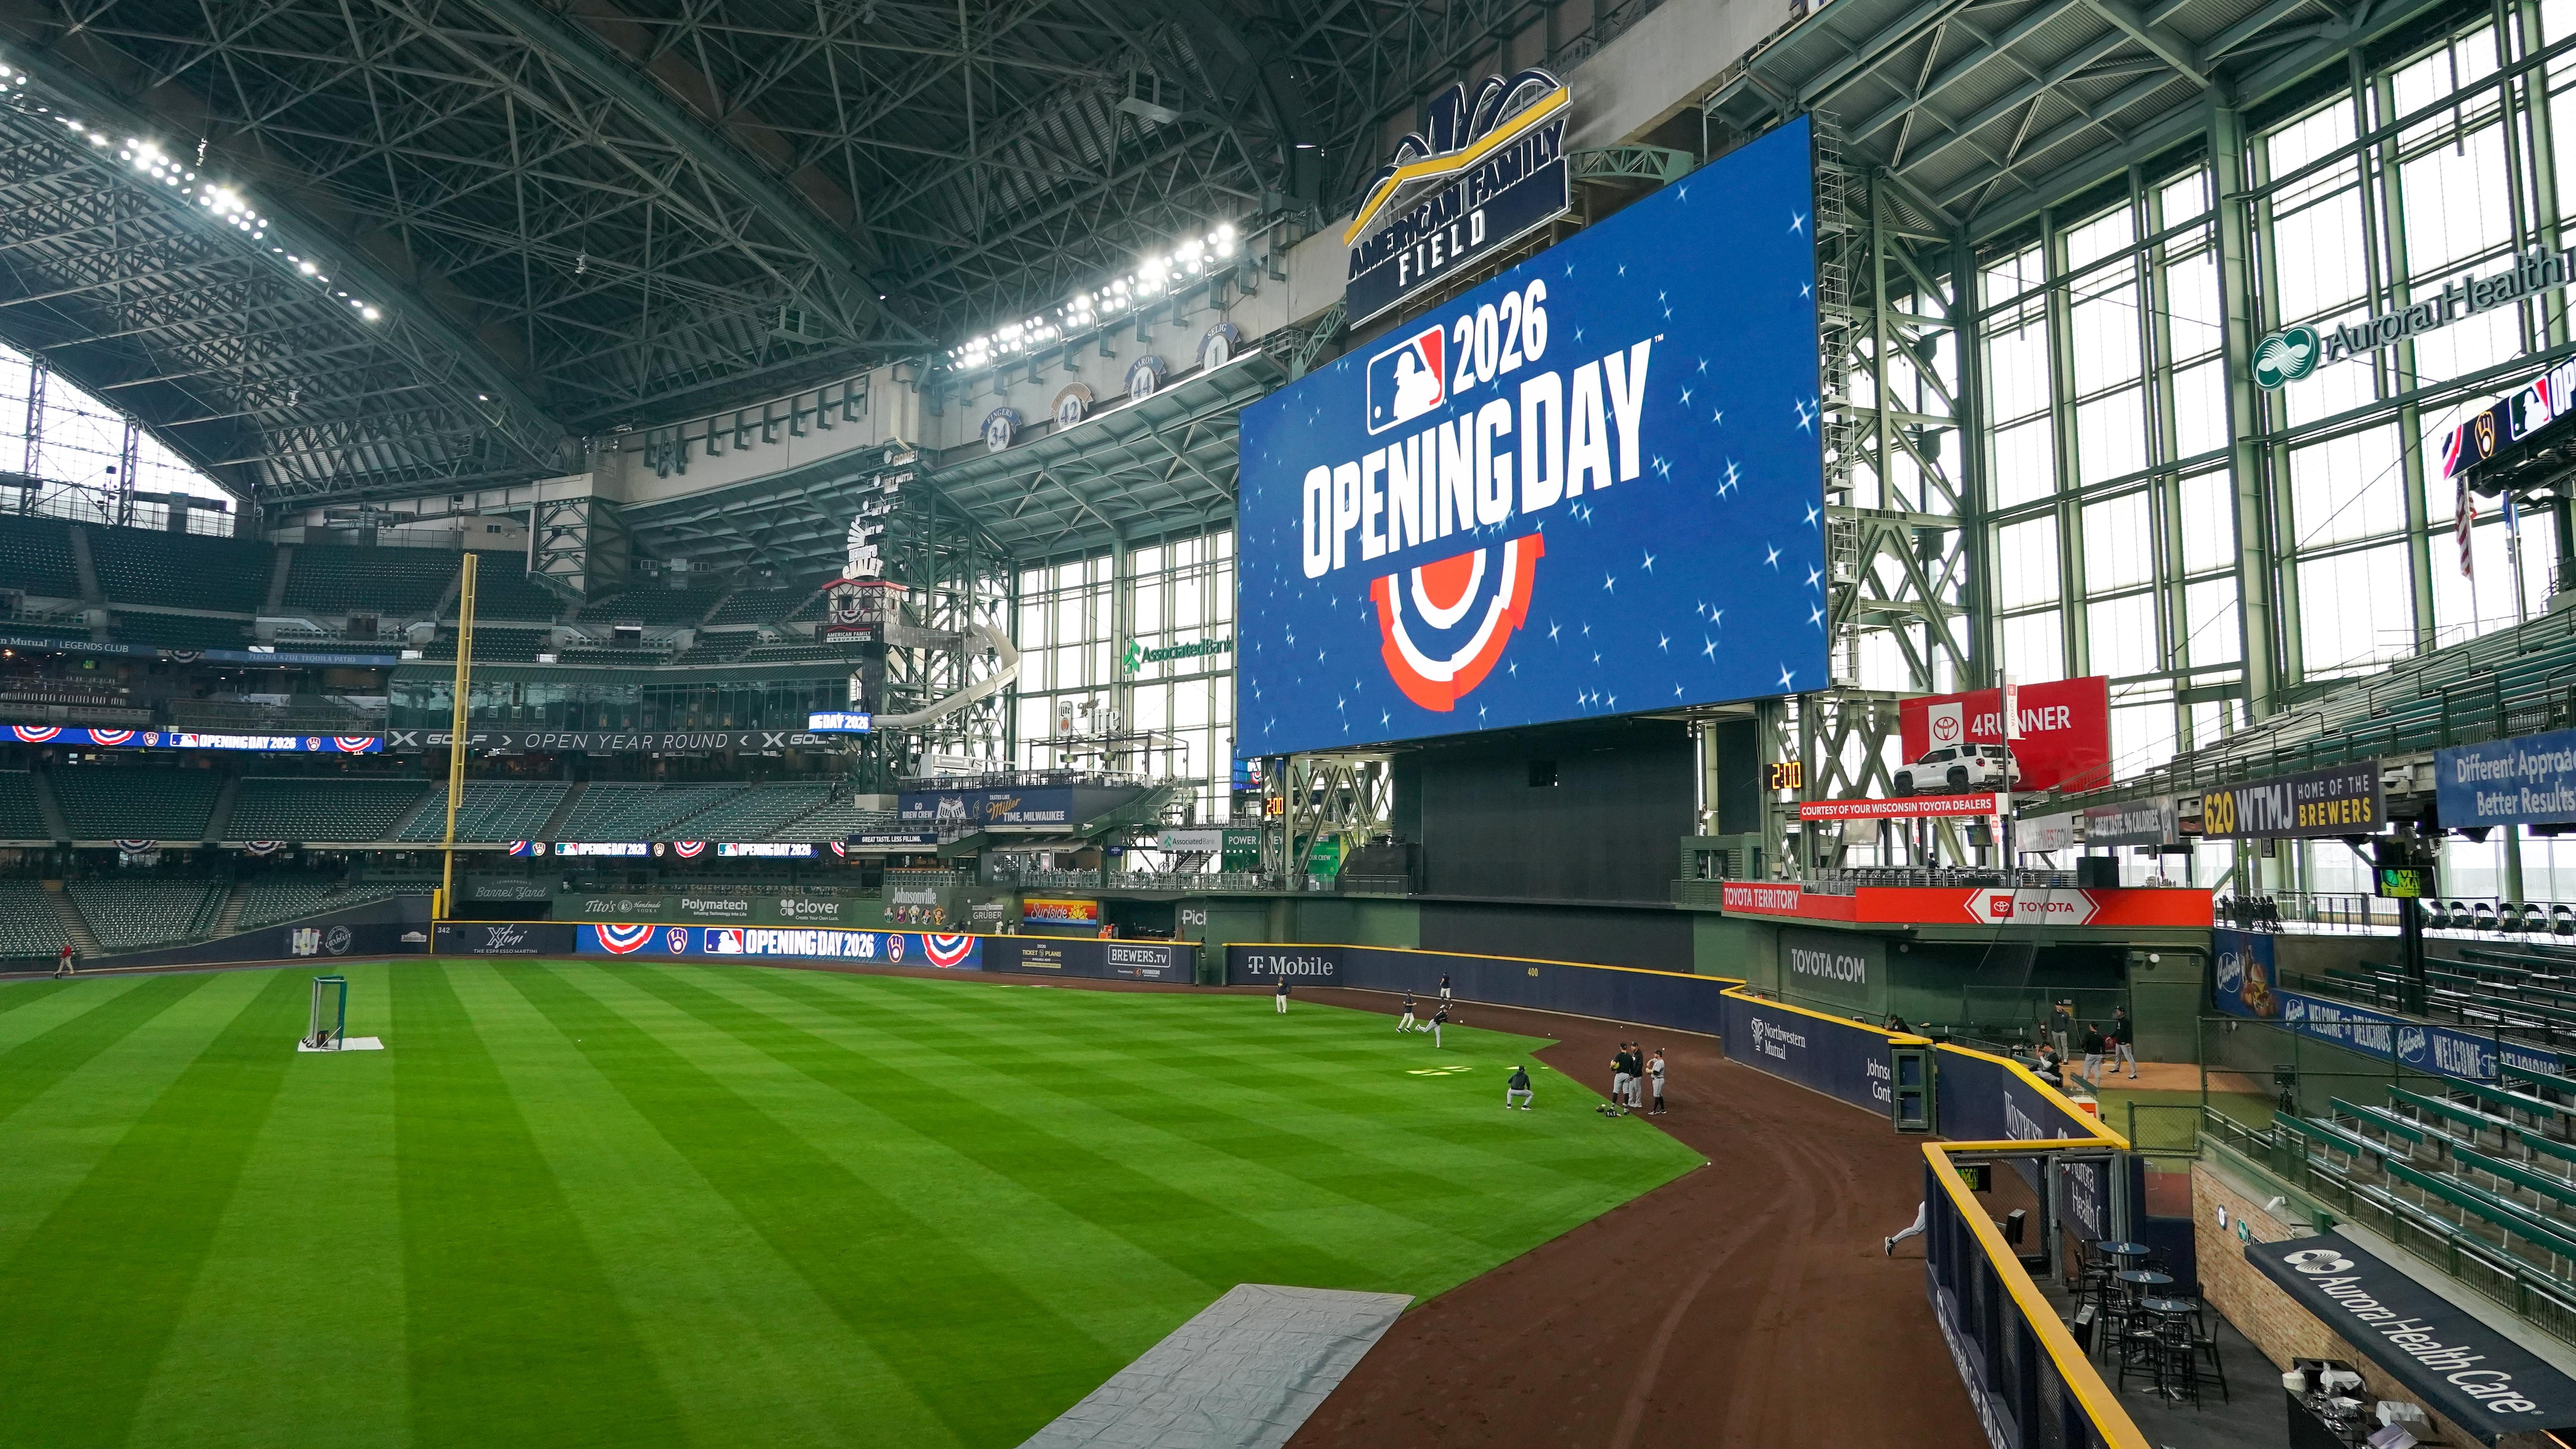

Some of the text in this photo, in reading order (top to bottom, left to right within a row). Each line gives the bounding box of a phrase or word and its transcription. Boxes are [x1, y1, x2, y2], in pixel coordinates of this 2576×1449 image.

[1348, 113, 1568, 280] AMERICAN FAMILY
[1399, 209, 1486, 287] FIELD
[2327, 300, 2438, 364] Aurora
[2441, 242, 2568, 324] Health
[1207, 323, 1227, 340] SELIG
[1452, 278, 1547, 395] 2026
[1133, 356, 1154, 371] AARON
[1213, 344, 1219, 366] 1
[1133, 373, 1152, 397] 44
[987, 408, 1013, 425] FINGERS
[1061, 401, 1080, 425] 42
[990, 424, 1008, 448] 34
[893, 449, 919, 467] GONE!
[1303, 338, 1652, 579] OPENING DAY
[884, 472, 913, 486] GET OUTTA
[883, 504, 891, 514] UP
[876, 525, 884, 534] UP
[849, 544, 877, 563] BERNIE'S
[842, 557, 884, 580] CHALET
[10, 638, 47, 647] Mutual
[59, 640, 103, 651] LEGENDS
[104, 644, 129, 652] CLUB
[1061, 706, 1071, 717] Lite
[1077, 699, 1101, 718] Miller
[823, 714, 845, 729] DAY
[844, 715, 869, 730] 2026
[1087, 709, 1121, 739] Lite
[199, 734, 297, 750] OPENING DAY 2026
[525, 734, 728, 749] OPEN YEAR ROUND
[1772, 761, 1802, 790] 2:00
[2456, 753, 2515, 783] Different
[2298, 774, 2369, 799] HOME OF THE
[914, 802, 923, 811] GO
[1266, 797, 1284, 815] 2:00
[1801, 798, 1992, 816] COURTESY OF YOUR WISCONSIN TOYOTA DEALERS
[2477, 781, 2575, 816] Better Results
[903, 810, 933, 819] BREW CREW
[986, 798, 1022, 821] Miller
[1004, 811, 1065, 823] TIME, MILWAUKEE
[2205, 783, 2293, 835] 620 WTMJ
[2299, 797, 2371, 827] BREWERS
[2095, 815, 2108, 836] GREAT
[2124, 812, 2132, 834] 96
[2132, 809, 2161, 833] CALORIES.
[578, 843, 647, 855] OPENING DAY 2026
[738, 843, 811, 856] OPENING DAY 2026
[1228, 836, 1257, 846] POWER
[475, 886, 546, 900] Barrel Yard
[892, 886, 937, 905] Johnsonville
[1724, 887, 1799, 910] TOYOTA TERRITORY
[585, 899, 616, 913] Tito's
[682, 898, 748, 912] Polymatech
[795, 899, 839, 914] clover
[1031, 903, 1067, 920] Surfside
[2019, 902, 2075, 913] TOYOTA
[973, 911, 1002, 920] GRUBER
[746, 929, 874, 958] OPENING DAY 2026
[1112, 949, 1167, 963] BREWERS.TV
[1268, 956, 1333, 975] Mobile
[1528, 967, 1538, 976] 400
[1791, 948, 1865, 984] TOYOTA.COM
[2217, 951, 2241, 990] Culver's
[1765, 1022, 1806, 1049] Northwestern
[2285, 1000, 2305, 1026] Culver's
[2309, 1004, 2343, 1039] WELCOME
[2352, 1014, 2392, 1053] DELICIOUS
[2398, 1026, 2426, 1058] Culver's
[2433, 1035, 2482, 1079] WELCOME
[1765, 1039, 1786, 1060] Mutual
[2072, 1181, 2096, 1233] Health
[2309, 1276, 2536, 1413] Aurora Health Care
[1944, 1309, 1980, 1413] Aurora Health Care
